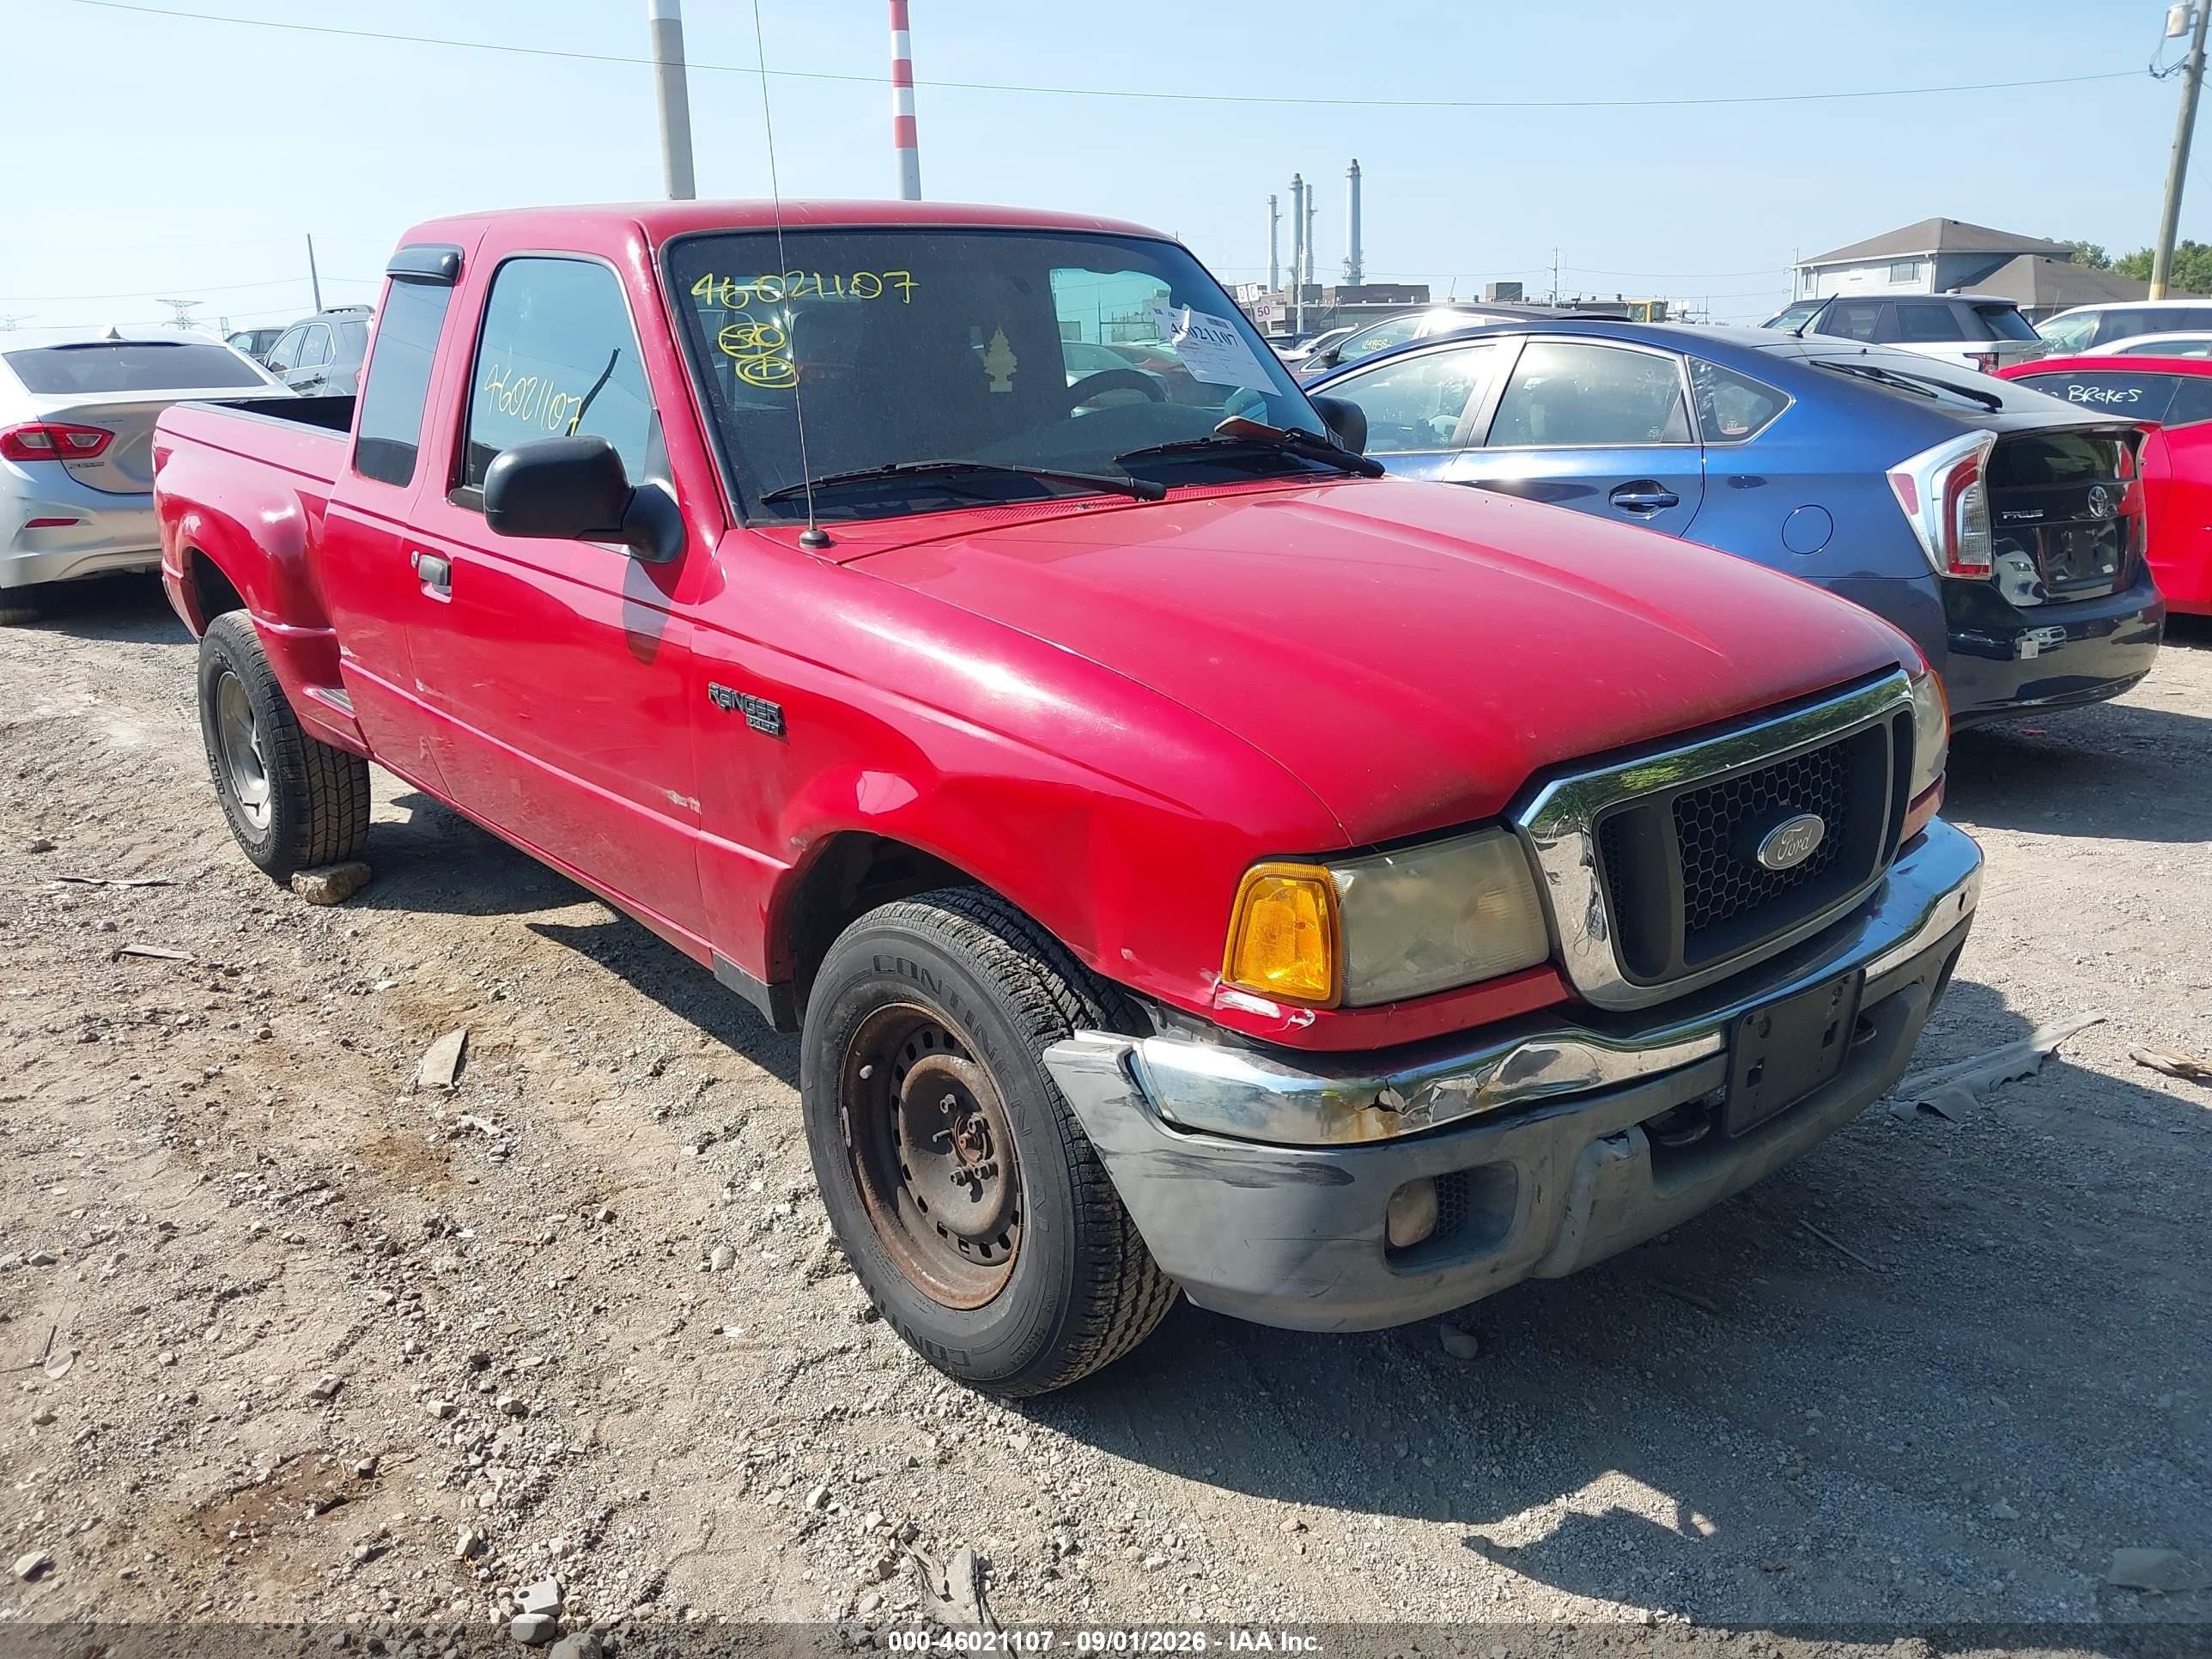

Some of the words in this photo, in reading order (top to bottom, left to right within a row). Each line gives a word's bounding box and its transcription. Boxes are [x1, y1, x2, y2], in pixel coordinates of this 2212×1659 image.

[690, 270, 920, 308] 46021107
[1257, 305, 1270, 317] 50
[484, 363, 581, 436] 46021107
[708, 681, 781, 724] RANGER
[1777, 825, 1813, 860] Ford
